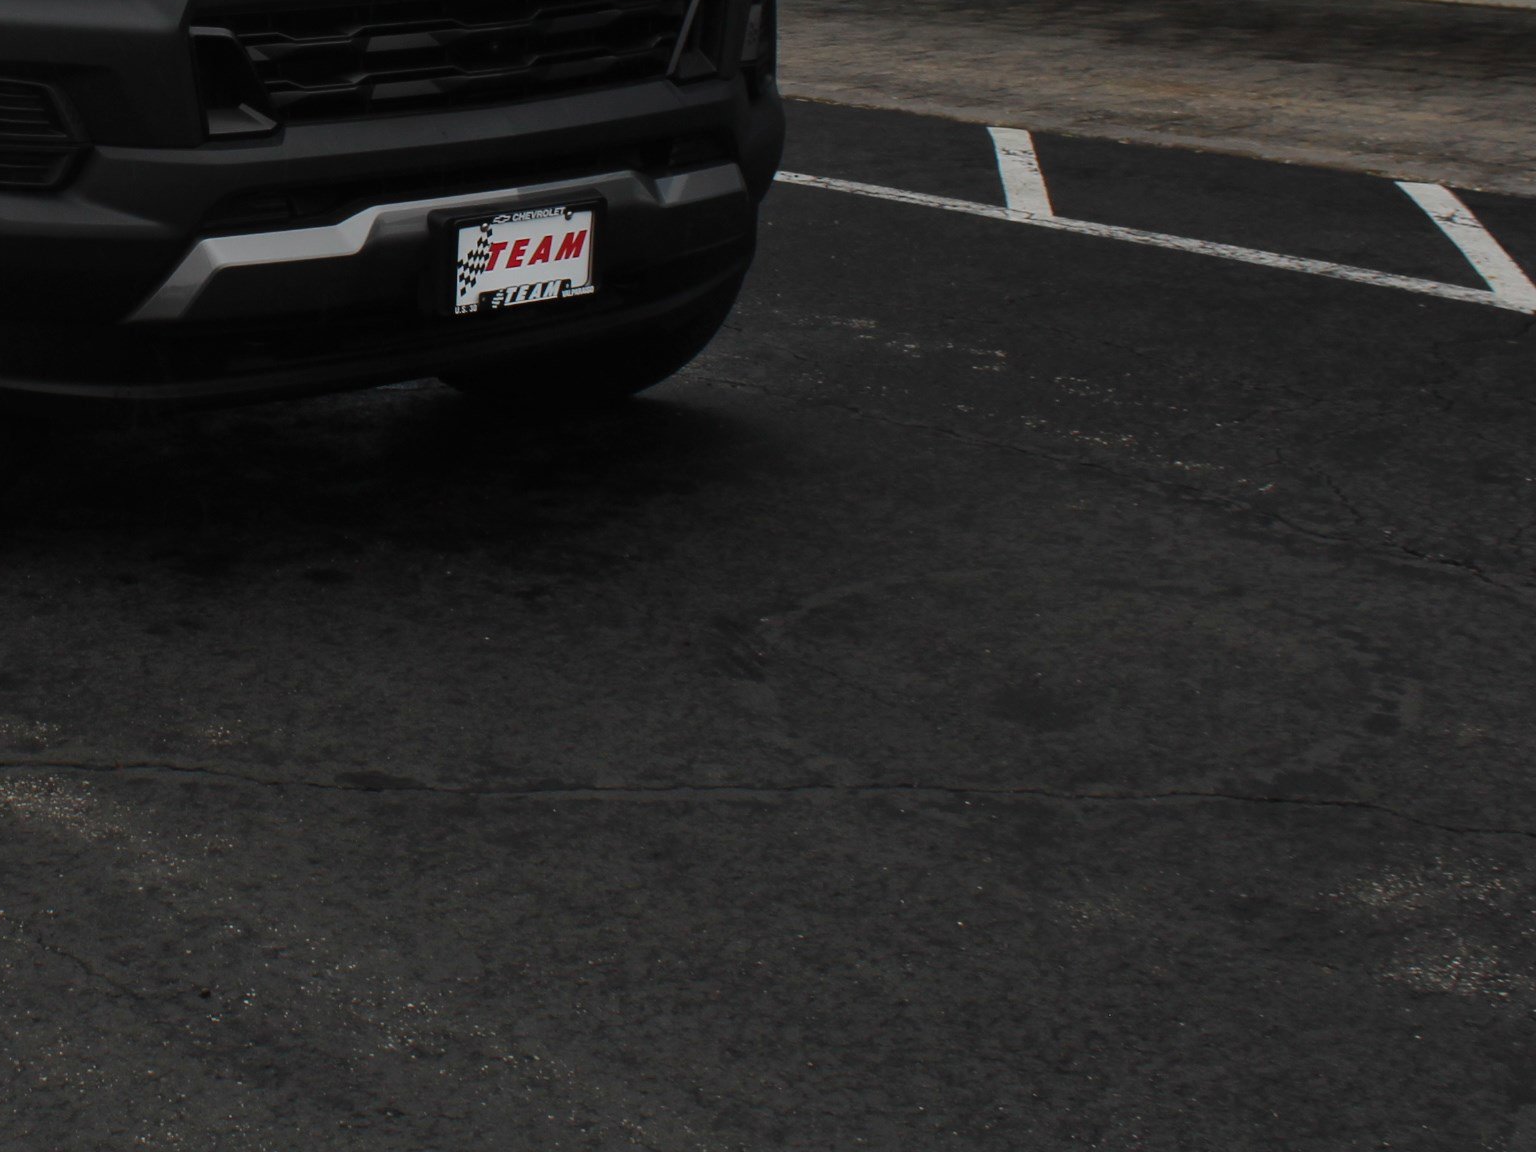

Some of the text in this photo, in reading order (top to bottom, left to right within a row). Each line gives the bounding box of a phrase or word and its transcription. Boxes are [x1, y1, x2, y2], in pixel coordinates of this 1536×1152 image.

[512, 206, 566, 222] CHEVROLET
[485, 229, 588, 272] TEAM
[504, 279, 562, 304] TEAM
